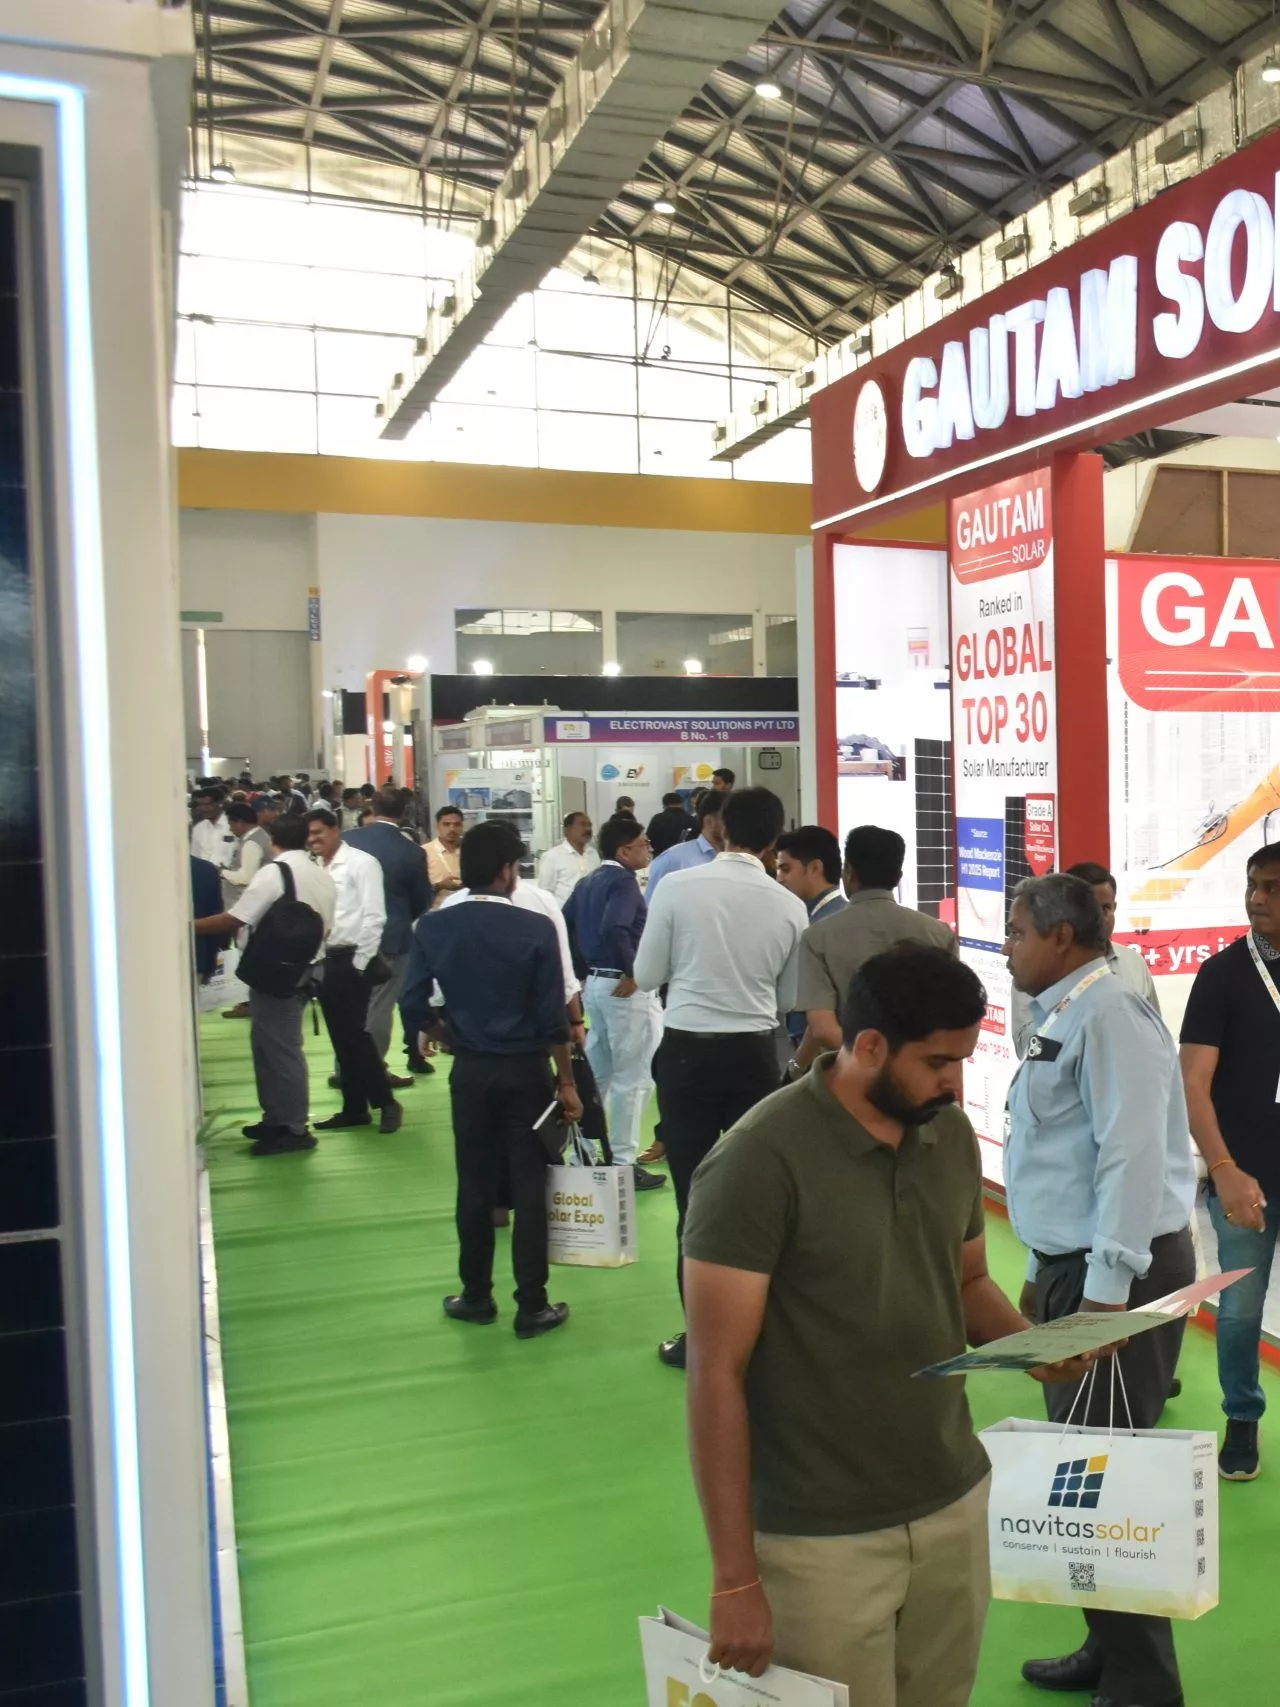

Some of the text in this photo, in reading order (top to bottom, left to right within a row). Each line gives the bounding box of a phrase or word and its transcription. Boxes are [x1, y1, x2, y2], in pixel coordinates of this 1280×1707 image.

[902, 255, 1138, 458] GAUTAM
[957, 487, 1044, 551] GAUTAM
[1011, 539, 1045, 565] SOLAR
[978, 592, 1023, 619] Ranked in
[956, 620, 1053, 682] GLOBAL
[610, 720, 796, 730] ELECTROVAST SOLUTIONS PVT LTD
[962, 690, 1048, 745] TOP 30
[680, 732, 689, 740] B
[691, 732, 708, 740] No.
[717, 732, 729, 740] 18
[963, 759, 1049, 778] Solar Manufacturer
[1028, 803, 1046, 817] Grade
[1029, 821, 1041, 832] Solar
[958, 846, 973, 859] Wood
[982, 865, 1001, 879] Report
[1168, 944, 1211, 972] yrs
[552, 1192, 593, 1207] Global
[547, 1209, 605, 1227] olar Expo
[1002, 1540, 1156, 1560] conserve sustain flourish
